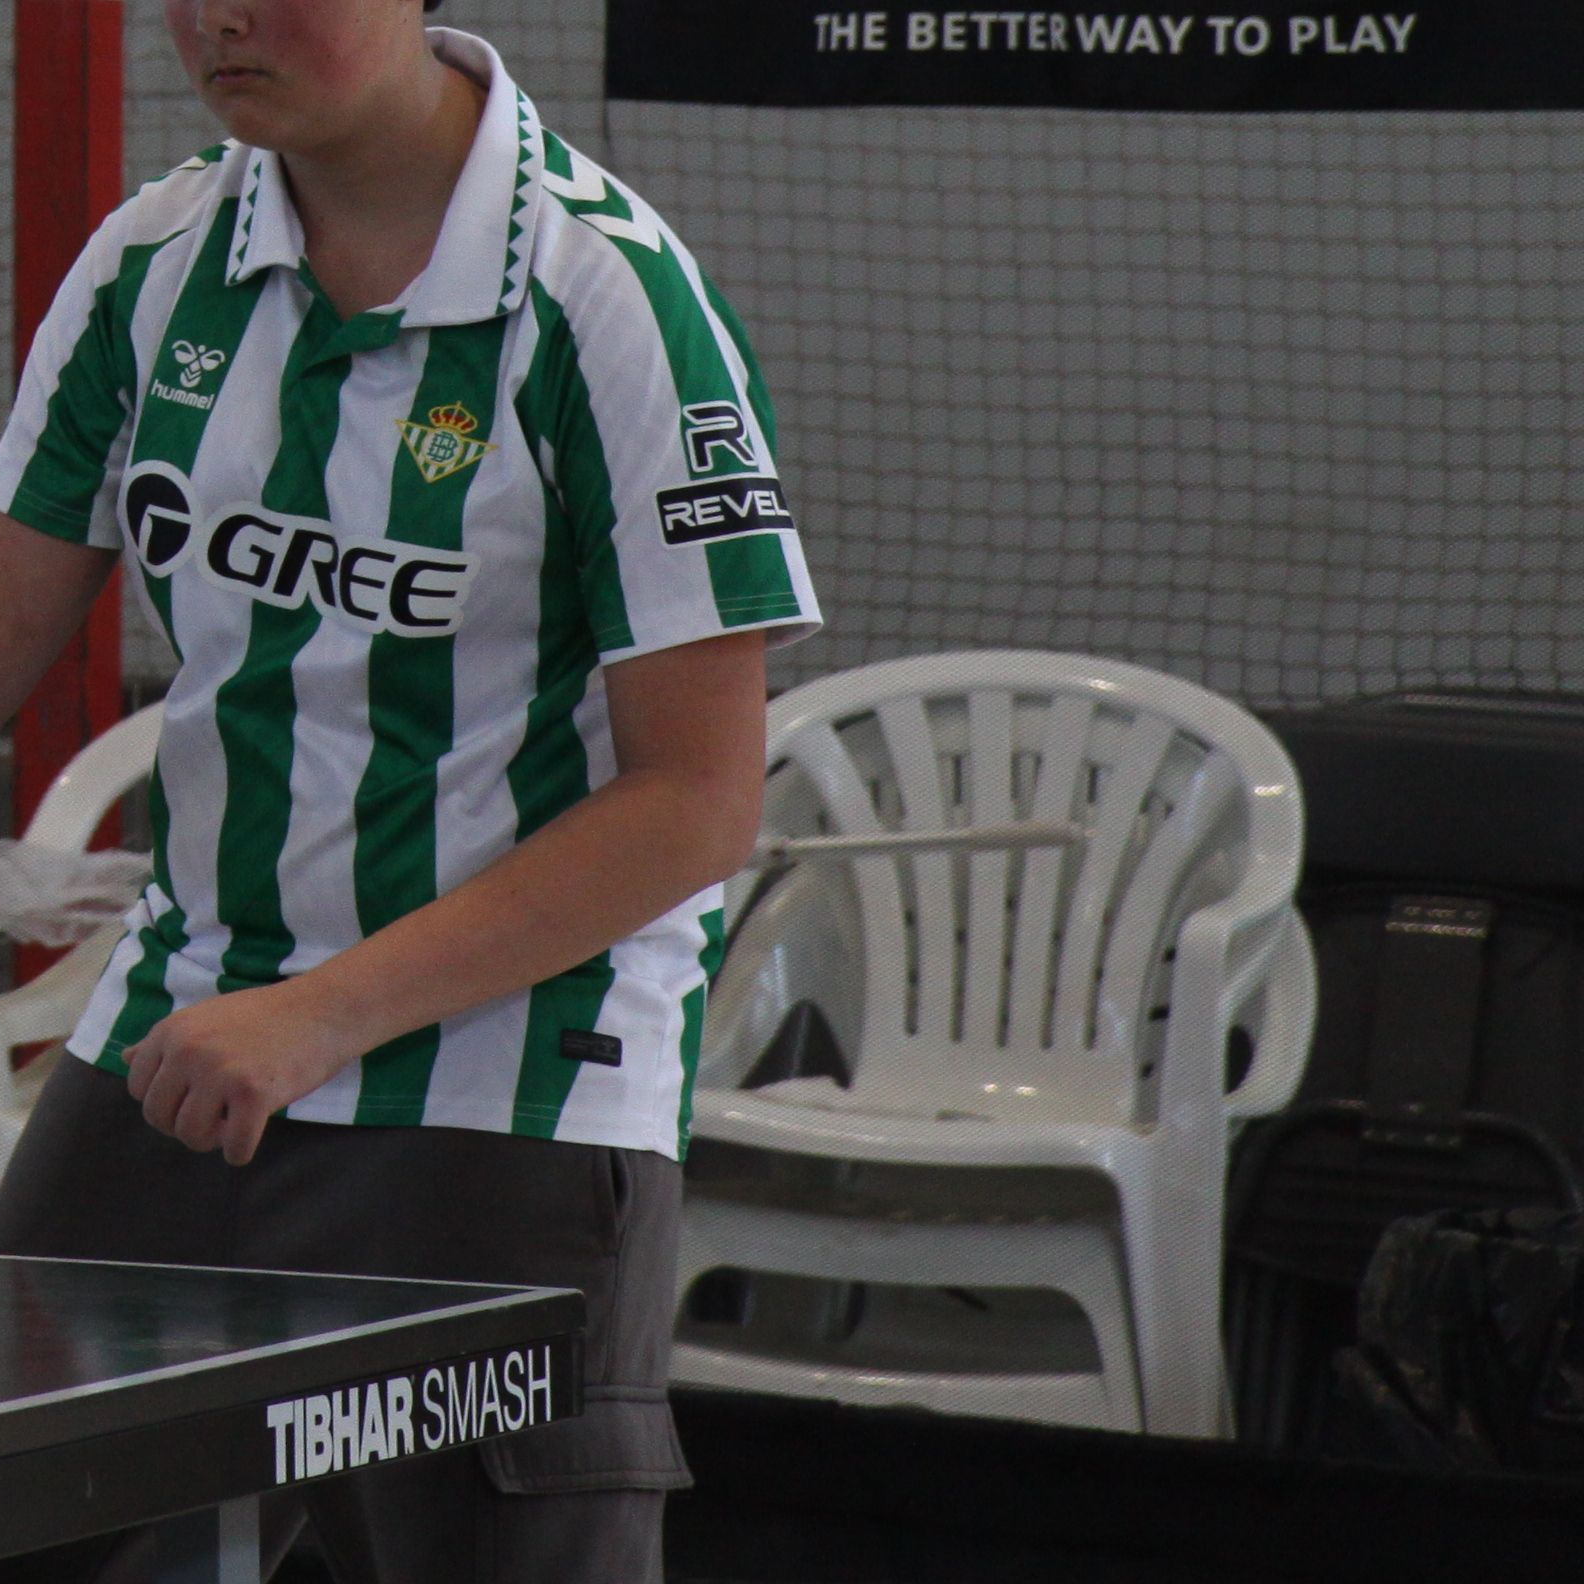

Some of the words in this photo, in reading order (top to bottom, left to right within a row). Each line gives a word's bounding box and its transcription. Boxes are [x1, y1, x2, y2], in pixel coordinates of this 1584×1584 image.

[815, 12, 887, 52] THE
[906, 12, 1069, 52] BETTER
[1075, 14, 1195, 55] WAY
[1206, 16, 1270, 56] TO
[1288, 13, 1416, 56] PLAY
[150, 378, 216, 411] hummel
[662, 489, 791, 532] REVEL
[207, 513, 468, 627] GREE
[266, 1376, 415, 1485] TIBHAR
[422, 1344, 552, 1451] SMASH
